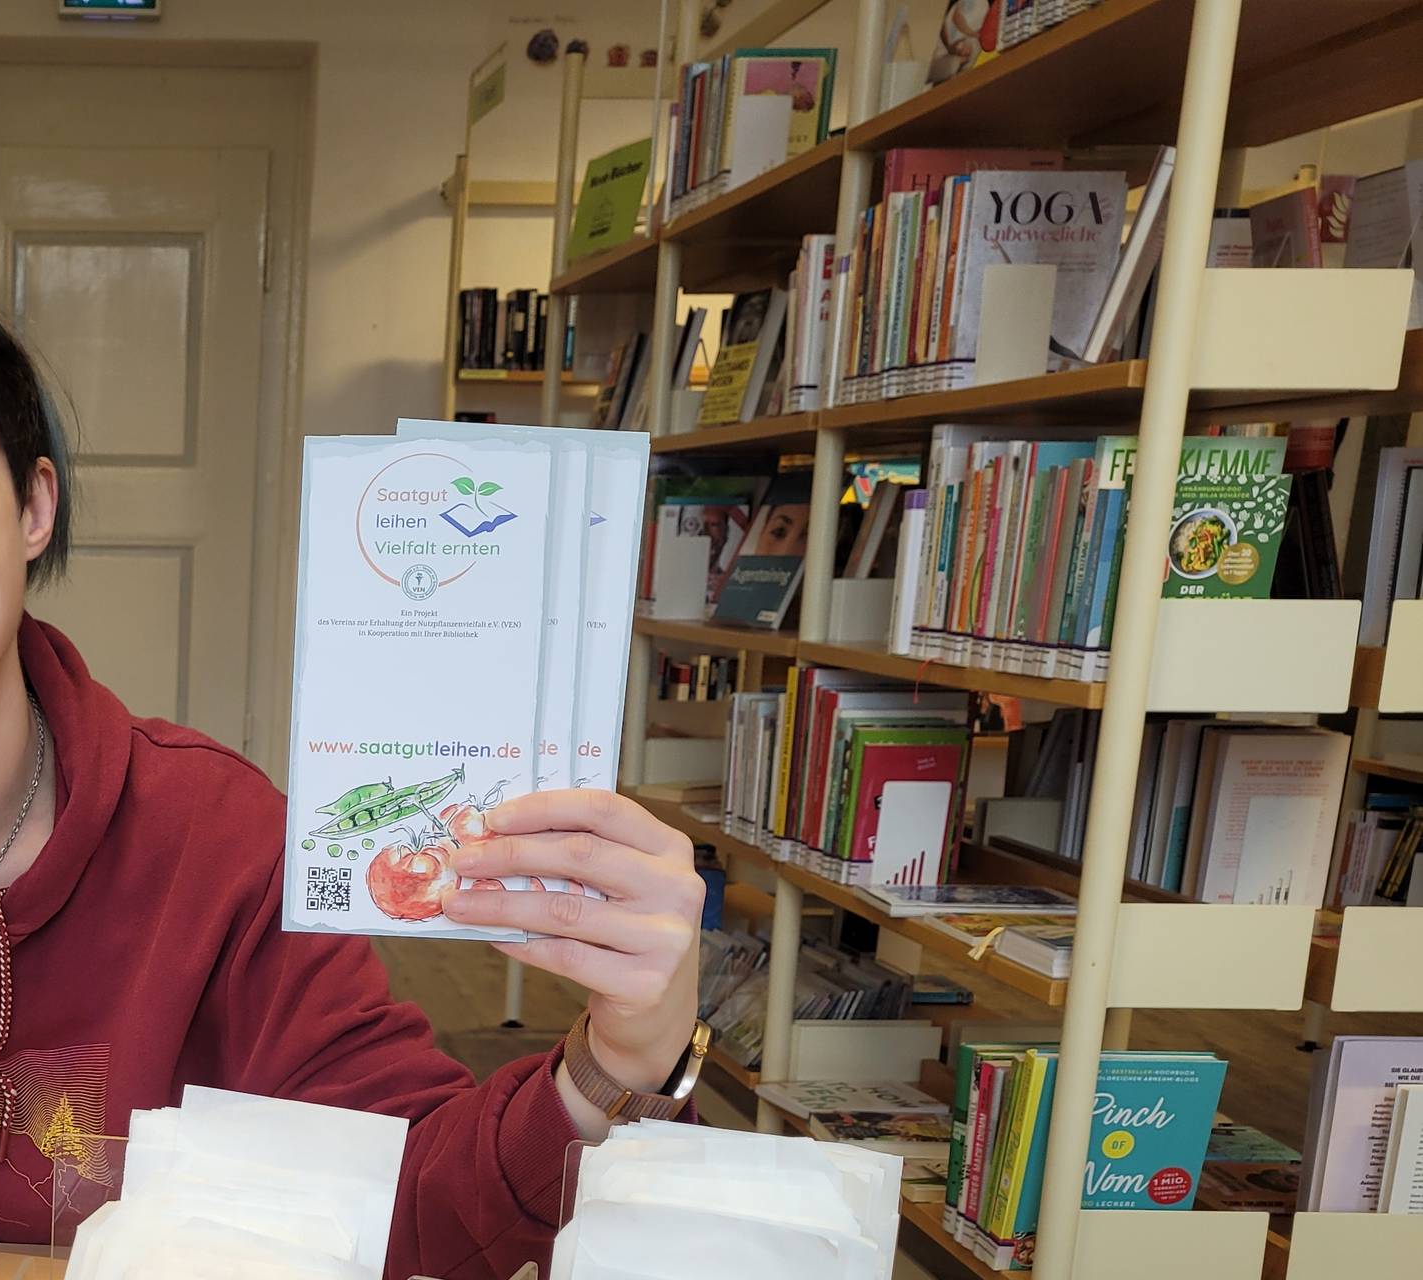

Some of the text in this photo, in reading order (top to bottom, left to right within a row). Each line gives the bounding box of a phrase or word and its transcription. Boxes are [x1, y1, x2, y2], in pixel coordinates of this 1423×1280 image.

[989, 191, 1104, 225] YOGA
[983, 224, 1101, 244] Unbewegliche
[377, 488, 448, 505] Saatgut
[376, 514, 427, 529] leihen
[375, 541, 500, 555] Vielfalt ernten
[1180, 585, 1205, 596] DER
[414, 610, 438, 618] Projekt
[370, 620, 404, 628] Erhaltung
[417, 620, 486, 629] Nutzpflanzenvielfalt
[501, 621, 522, 629] (VEN)
[367, 630, 409, 638] Kooperation
[309, 740, 521, 759] www.saatgutleihen.de
[1092, 1093, 1175, 1128] Pinch
[1111, 1140, 1126, 1150] OF
[1085, 1161, 1150, 1195] Nom
[1161, 1177, 1187, 1185] MIO.
